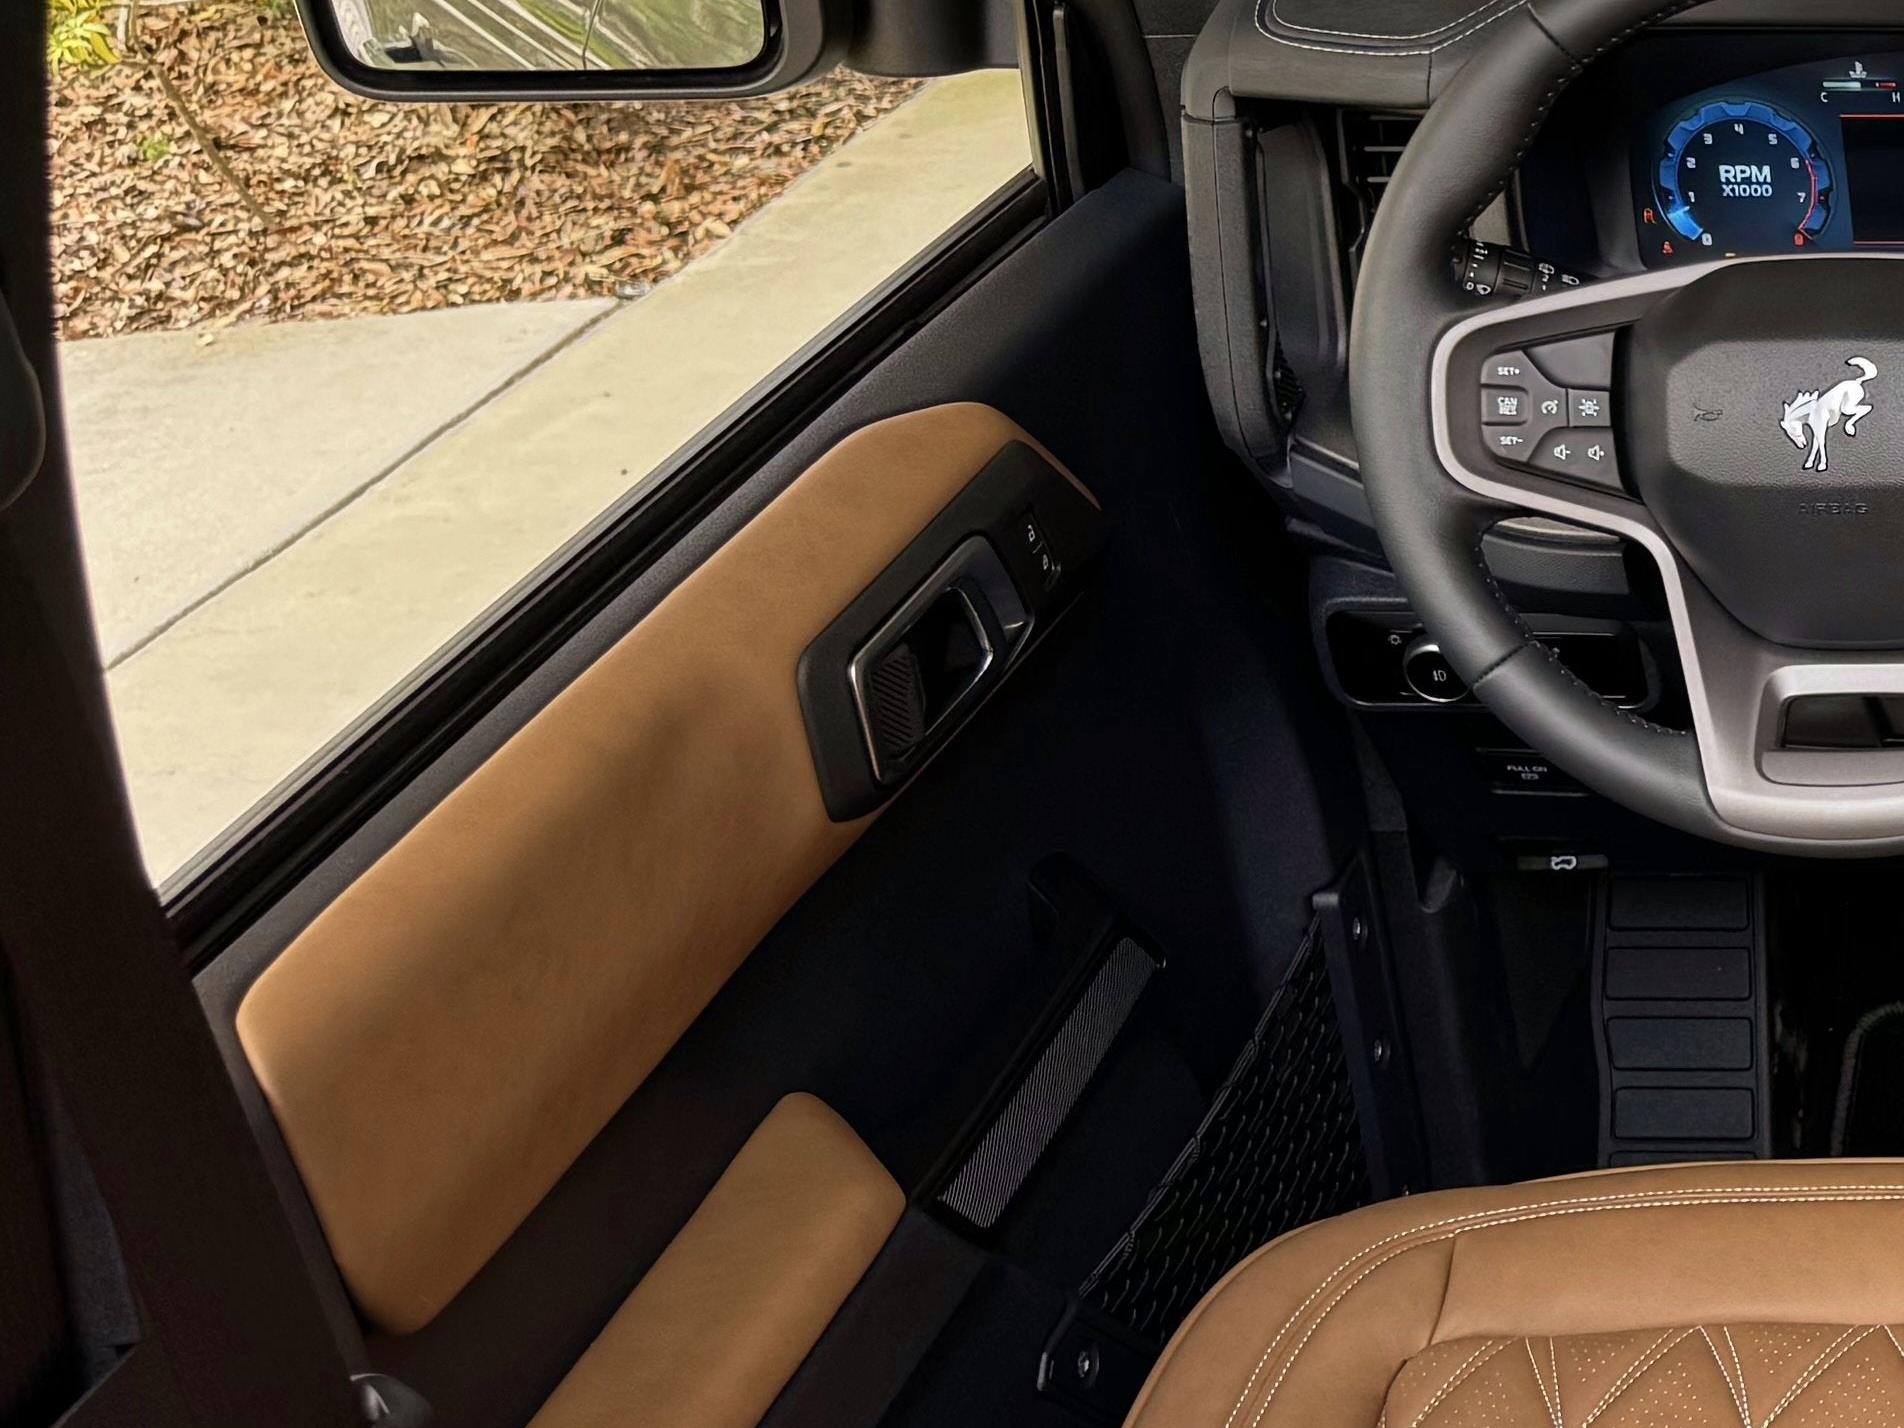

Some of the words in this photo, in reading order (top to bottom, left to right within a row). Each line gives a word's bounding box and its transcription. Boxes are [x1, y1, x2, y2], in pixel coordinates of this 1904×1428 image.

[1820, 91, 1828, 103] C
[1892, 92, 1901, 104] H
[1734, 123, 1744, 135] 4
[1703, 133, 1713, 145] 3
[1768, 133, 1778, 145] 5
[1686, 157, 1696, 169] 2
[1790, 157, 1800, 169] 6
[1718, 164, 1772, 183] RPM
[1722, 184, 1773, 197] X1000
[1688, 191, 1695, 203] 1
[1797, 192, 1806, 203] 7
[1702, 233, 1713, 246] 0
[1497, 397, 1518, 406] CAN
